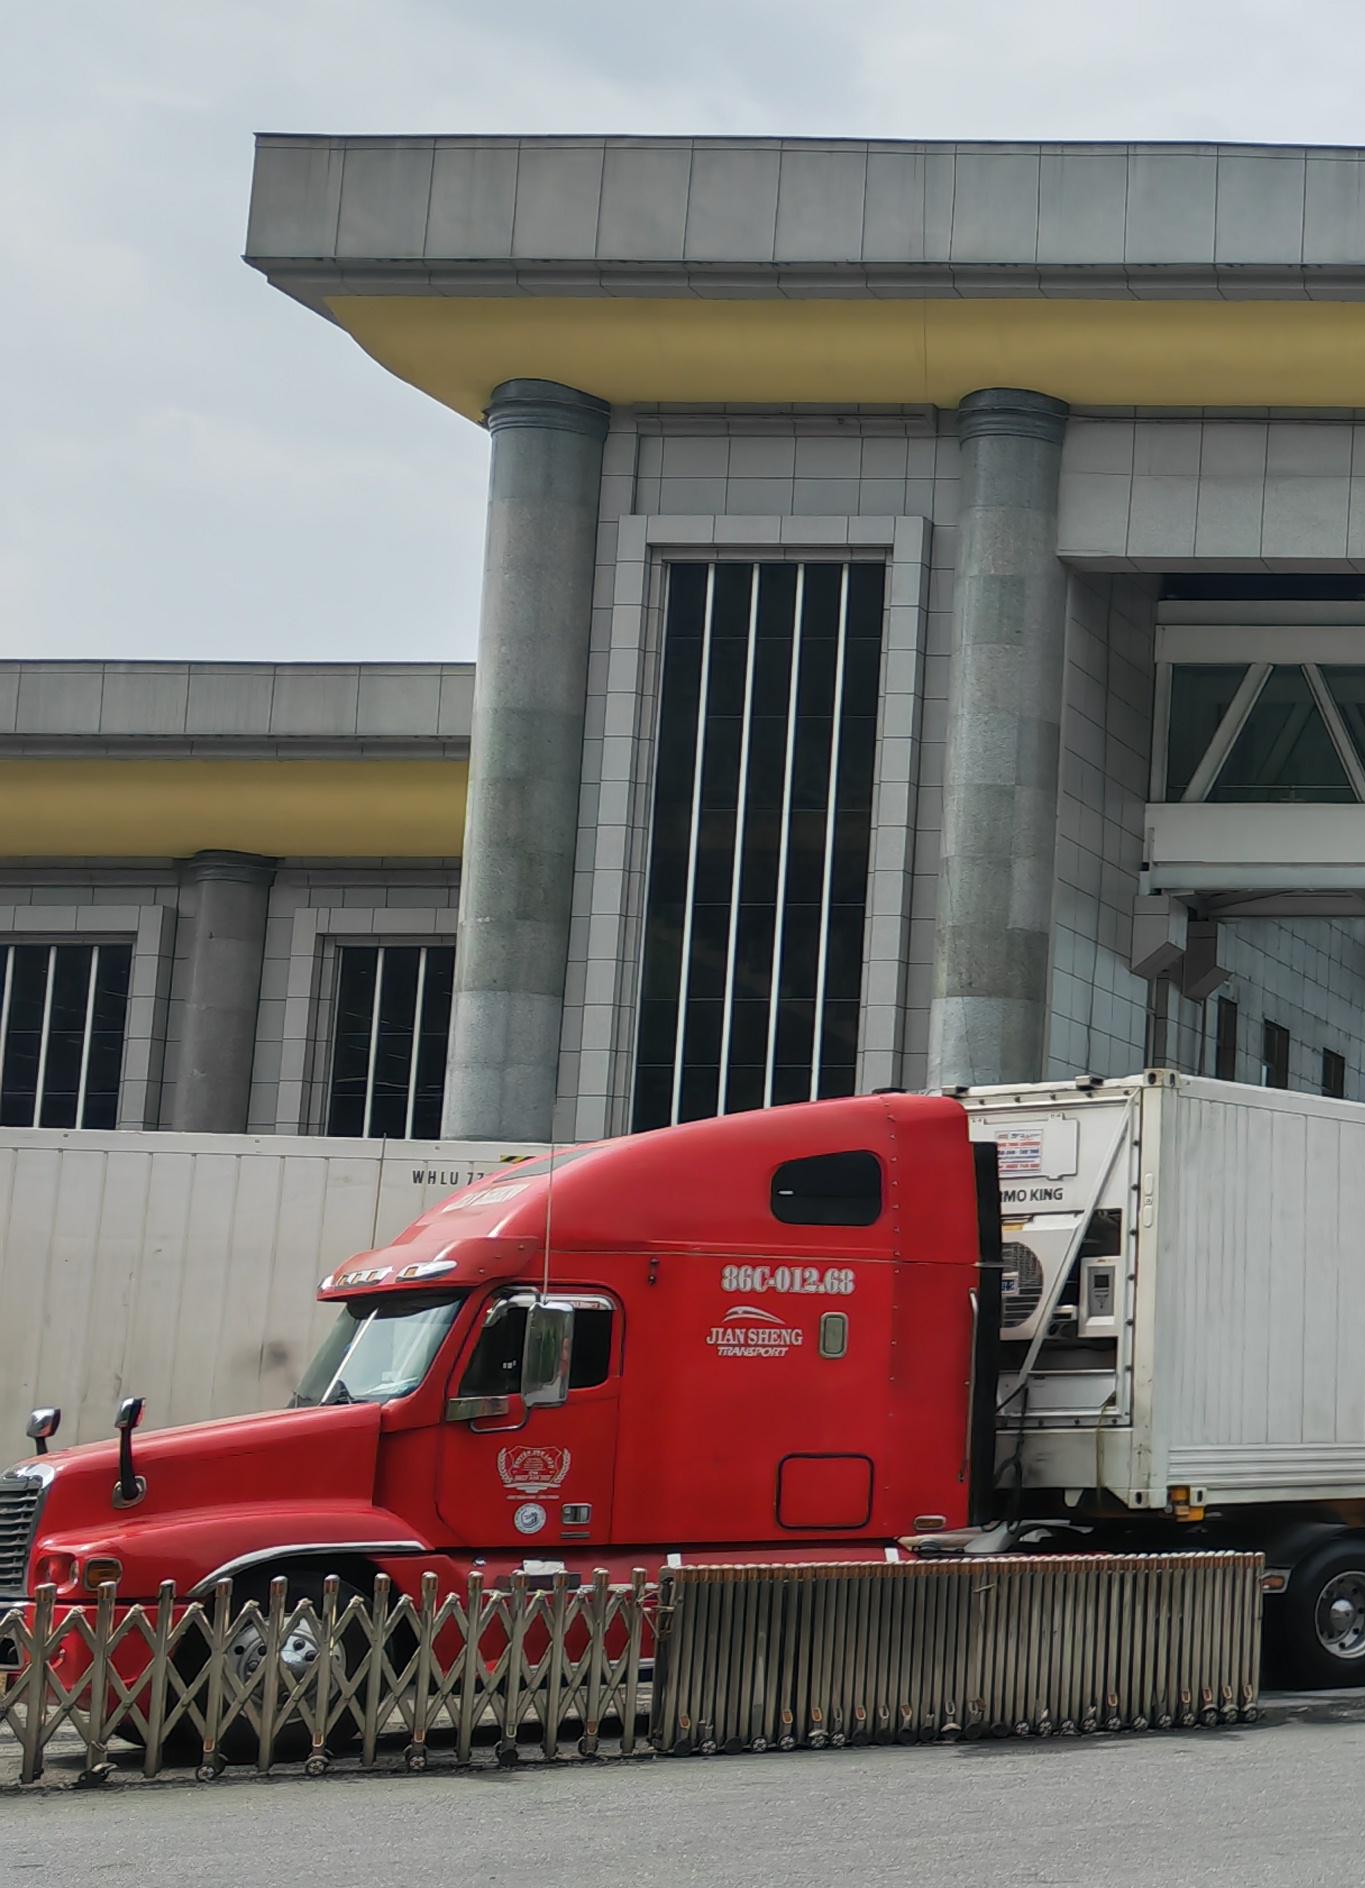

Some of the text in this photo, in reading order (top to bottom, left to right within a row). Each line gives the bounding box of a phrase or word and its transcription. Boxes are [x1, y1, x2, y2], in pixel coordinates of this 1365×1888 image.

[412, 1170, 459, 1185] WHLU
[1030, 1188, 1063, 1201] KING
[721, 1264, 856, 1295] 86C-012.68
[706, 1328, 804, 1345] JIAN SHENG
[717, 1346, 789, 1357] TRANSPORT
